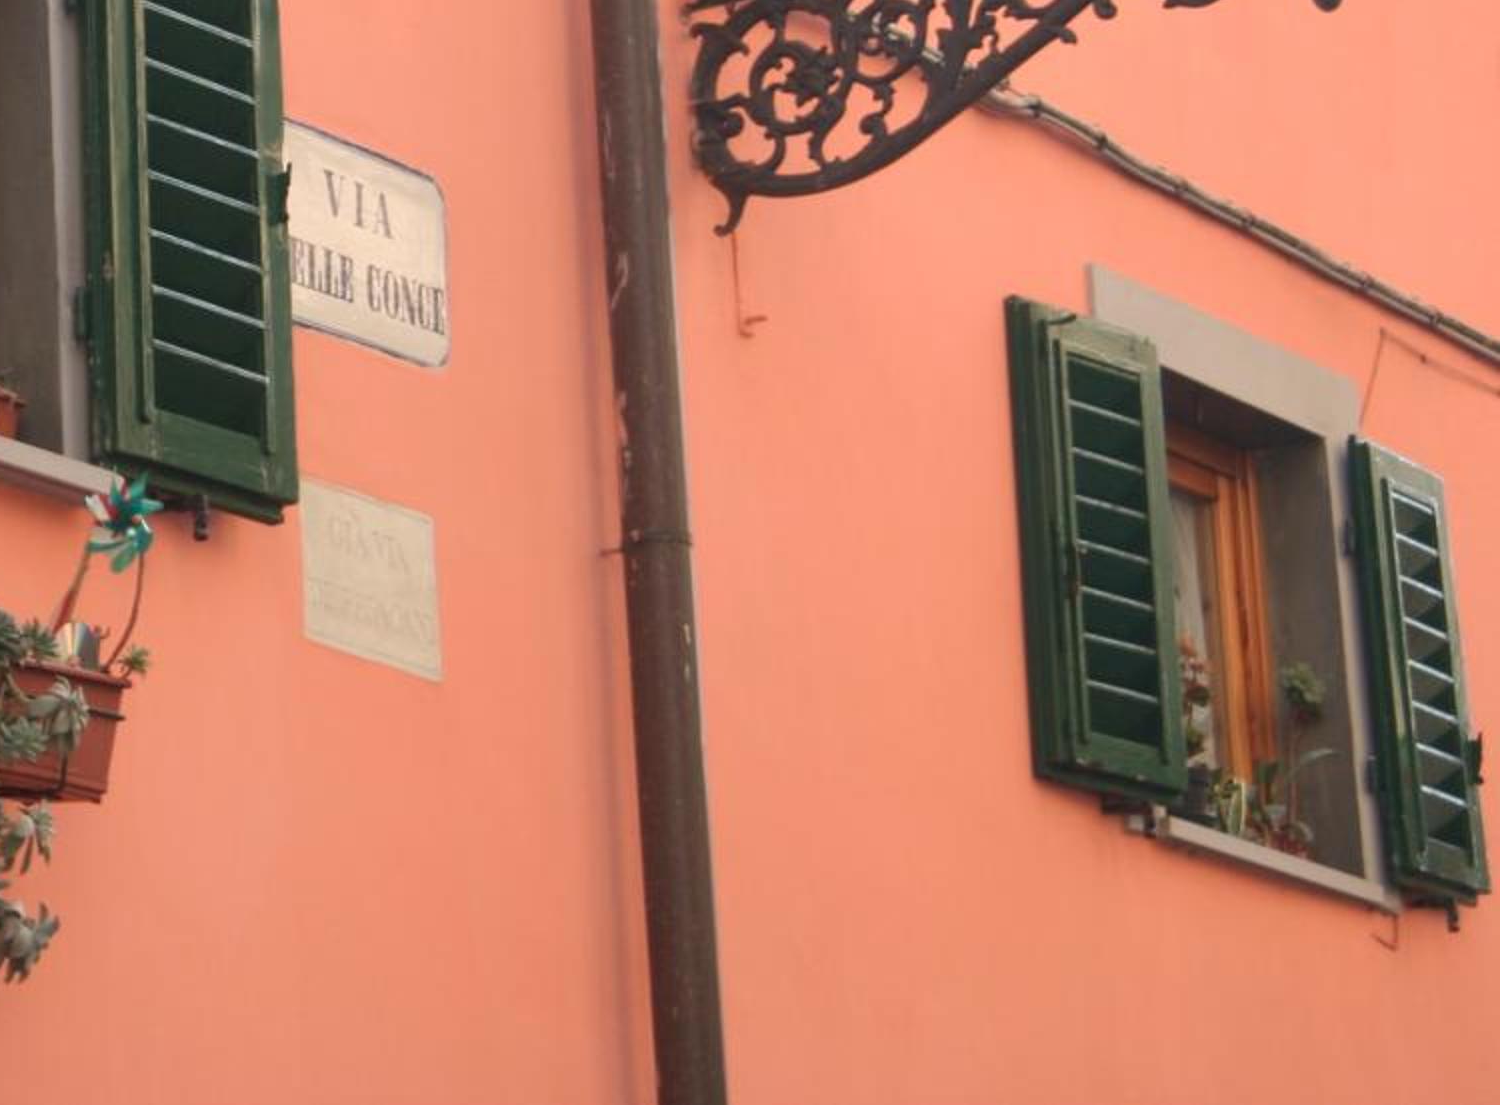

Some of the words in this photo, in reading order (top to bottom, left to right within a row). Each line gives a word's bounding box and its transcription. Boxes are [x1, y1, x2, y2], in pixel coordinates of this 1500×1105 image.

[323, 169, 394, 240] VIA
[291, 236, 354, 303] ELLE
[367, 263, 445, 335] CONCE
